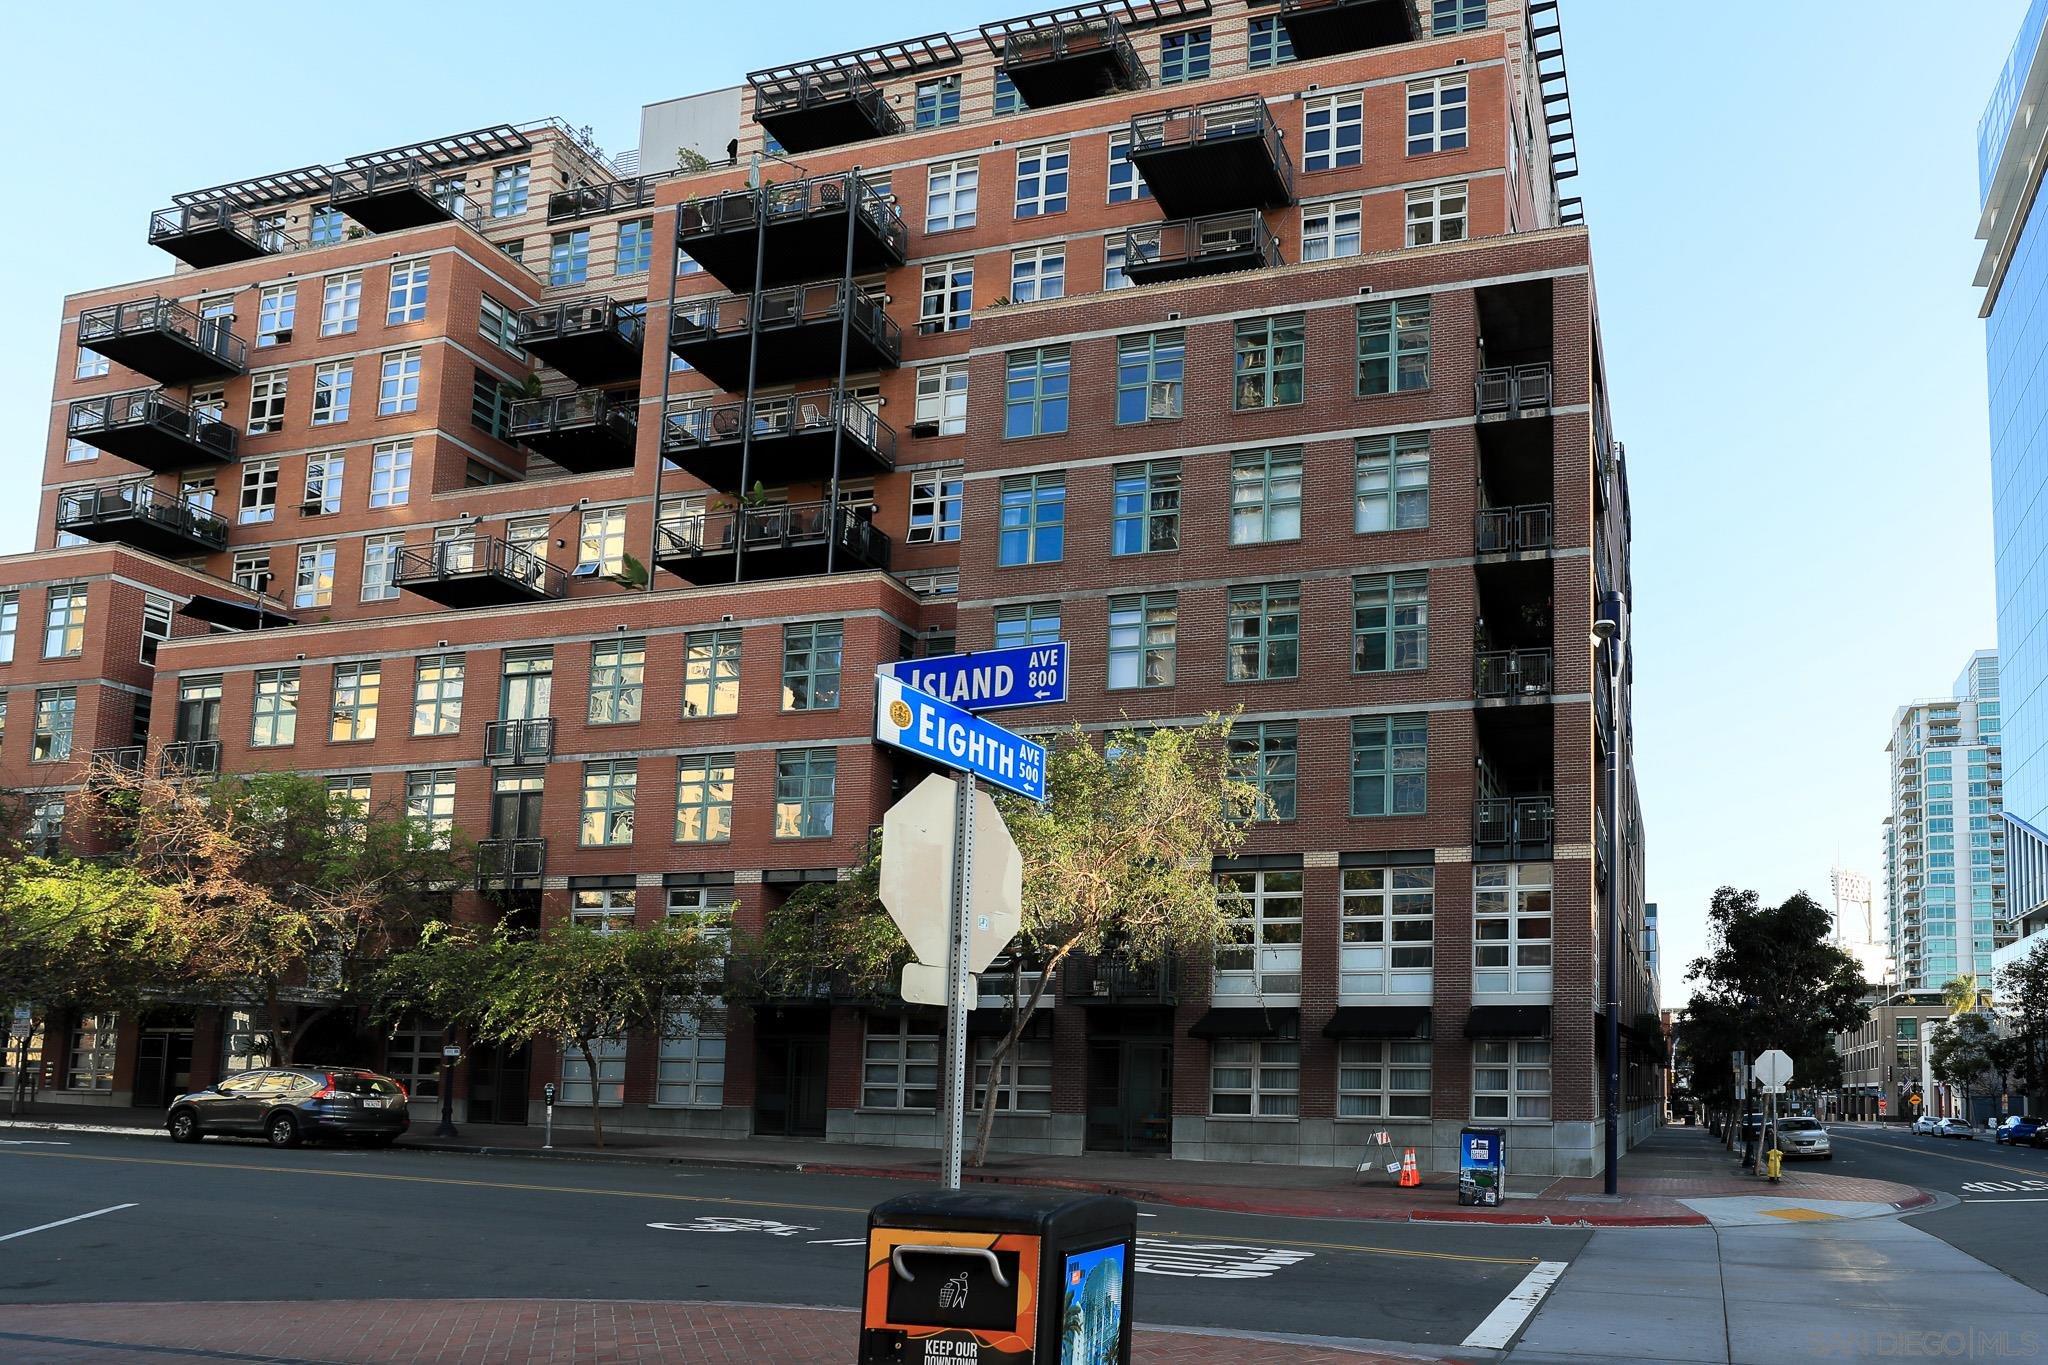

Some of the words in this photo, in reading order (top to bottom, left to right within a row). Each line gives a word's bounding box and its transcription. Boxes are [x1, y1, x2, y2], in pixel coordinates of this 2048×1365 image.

[1029, 649, 1058, 668] AVE
[912, 665, 1014, 702] ISLAND
[1028, 669, 1057, 688] 800
[919, 703, 1014, 778] EIGHTH
[1019, 744, 1039, 766] AVE
[1018, 761, 1039, 783] 500
[925, 1339, 954, 1356] KEEP
[955, 1341, 978, 1358] OUR
